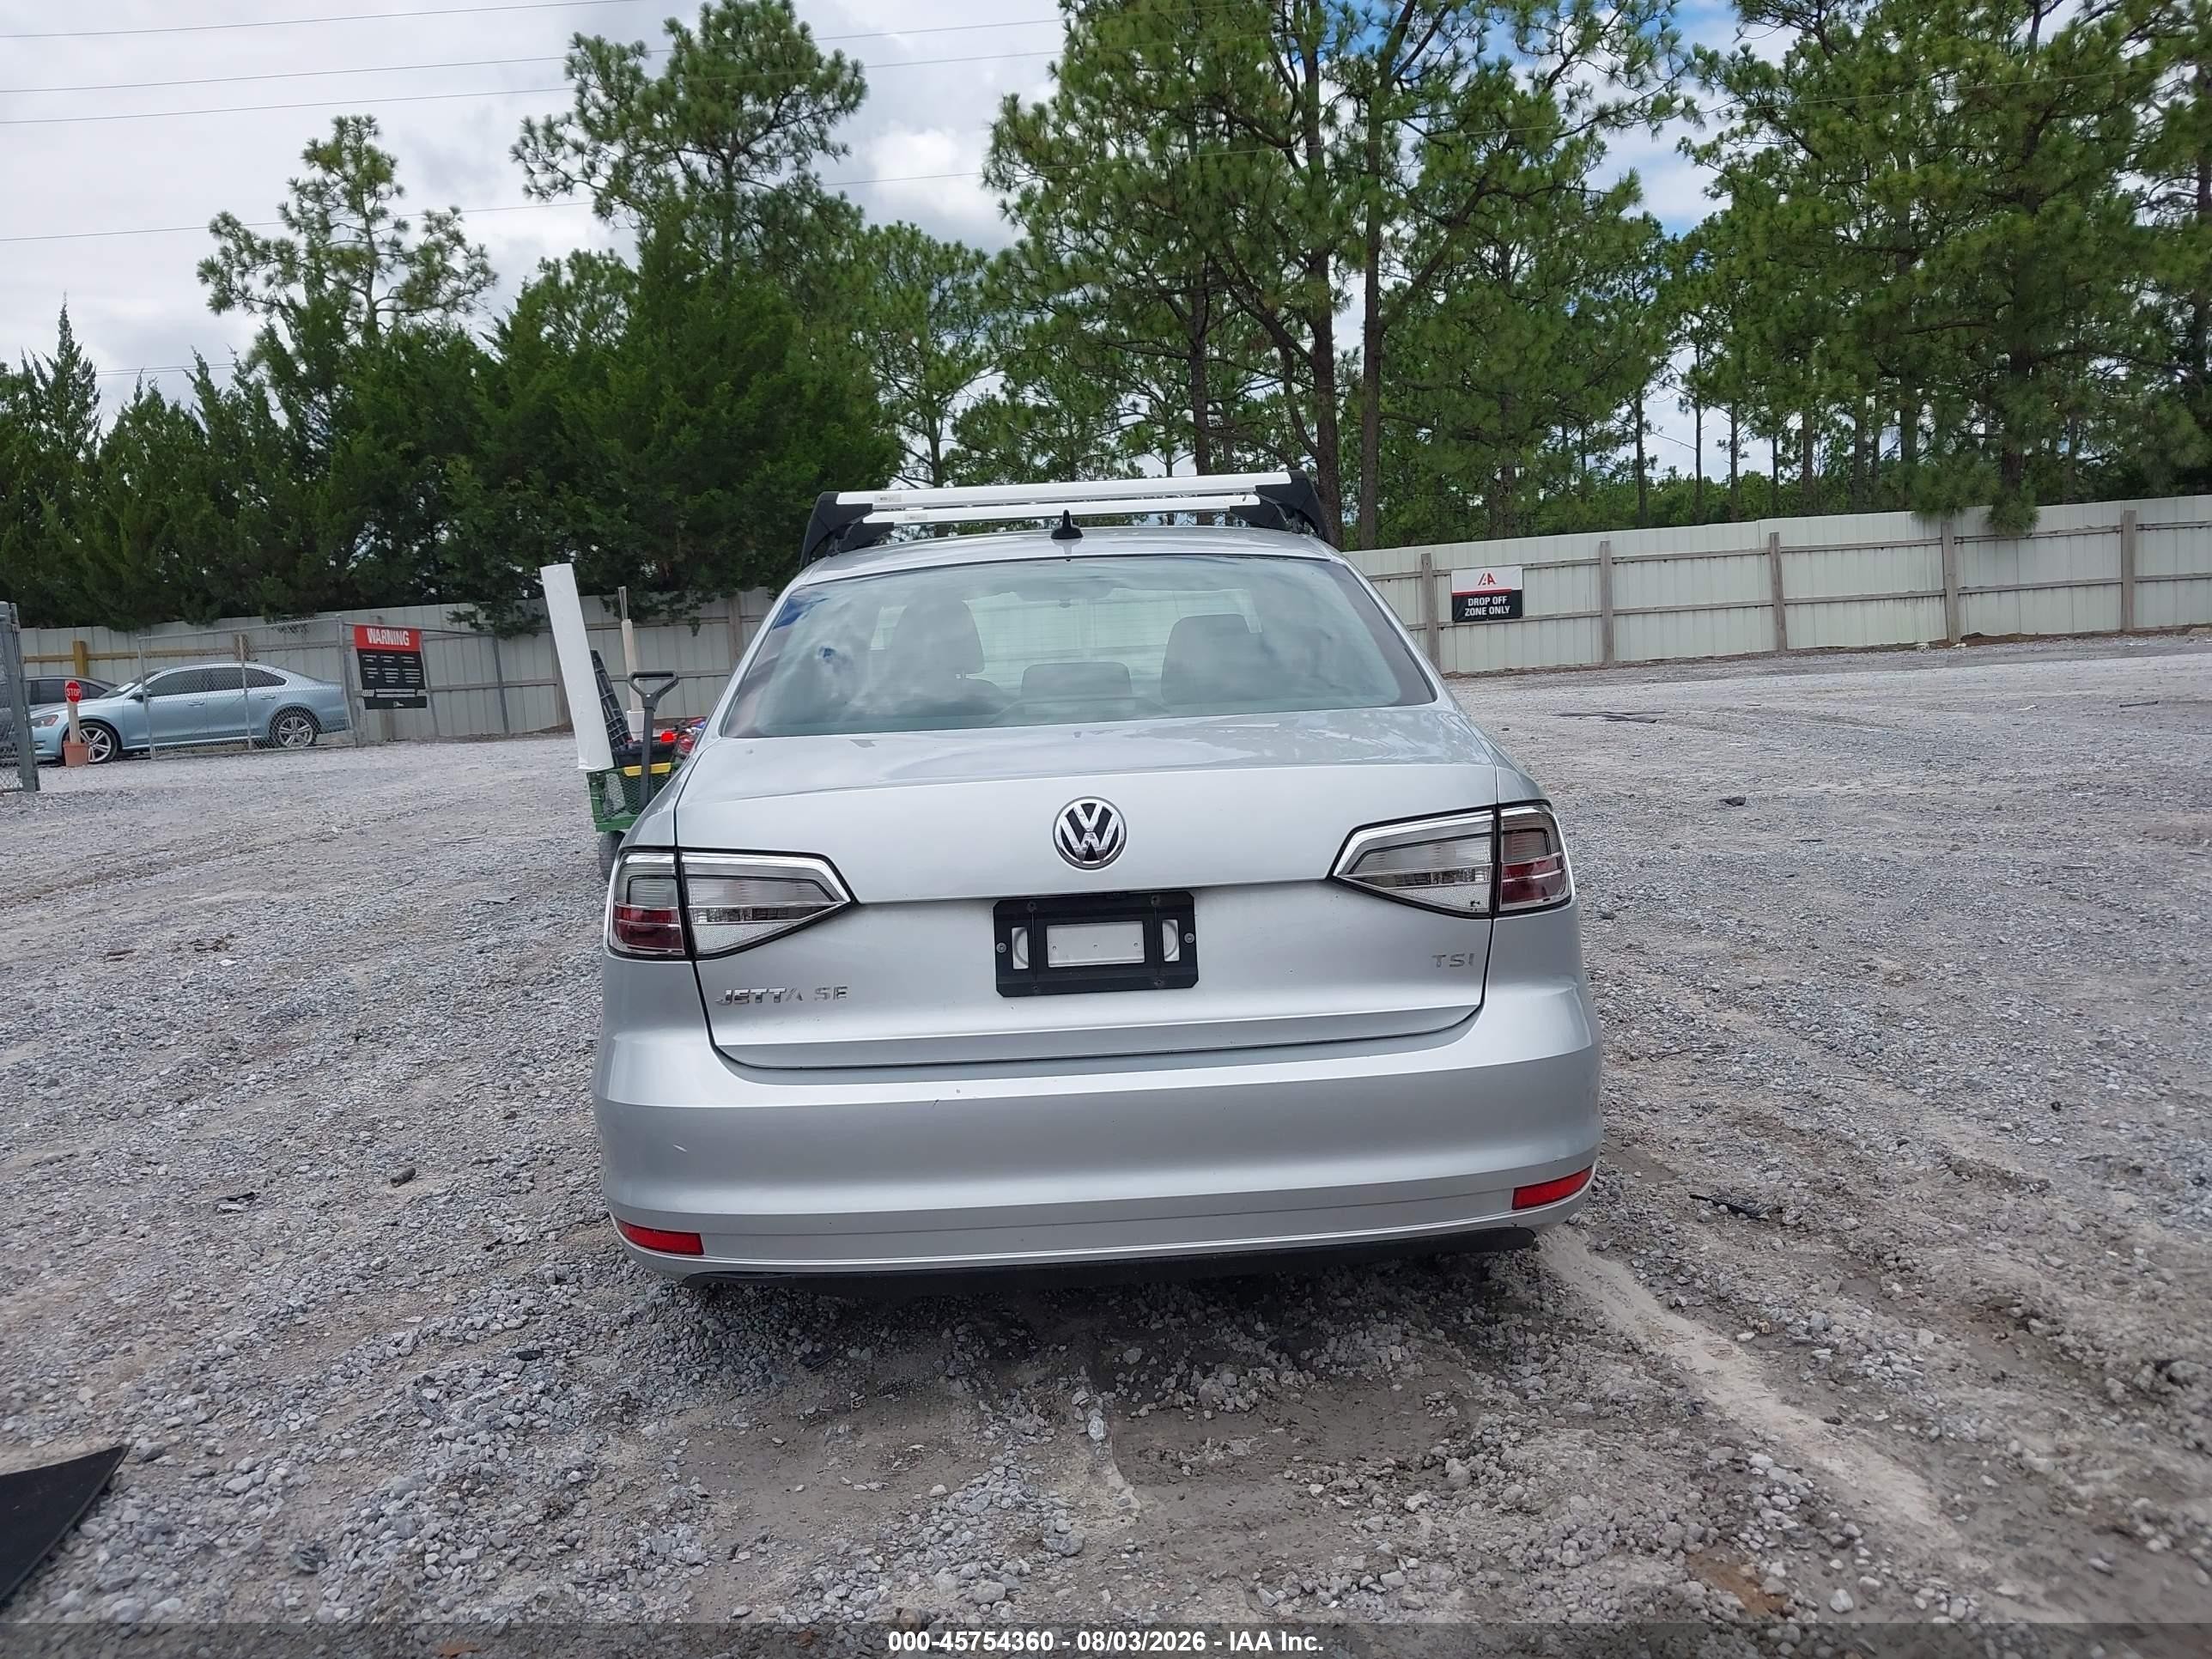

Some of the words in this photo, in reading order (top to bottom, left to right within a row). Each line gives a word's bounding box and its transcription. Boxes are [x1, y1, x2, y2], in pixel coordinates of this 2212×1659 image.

[1468, 598, 1491, 606] DROP
[1492, 596, 1508, 605] OFF
[1464, 607, 1487, 617] ZONE
[1489, 605, 1510, 614] ONLY
[366, 628, 410, 647] WARNING
[66, 688, 81, 697] STOP
[714, 988, 804, 1006] JETTA
[815, 987, 848, 1001] SE
